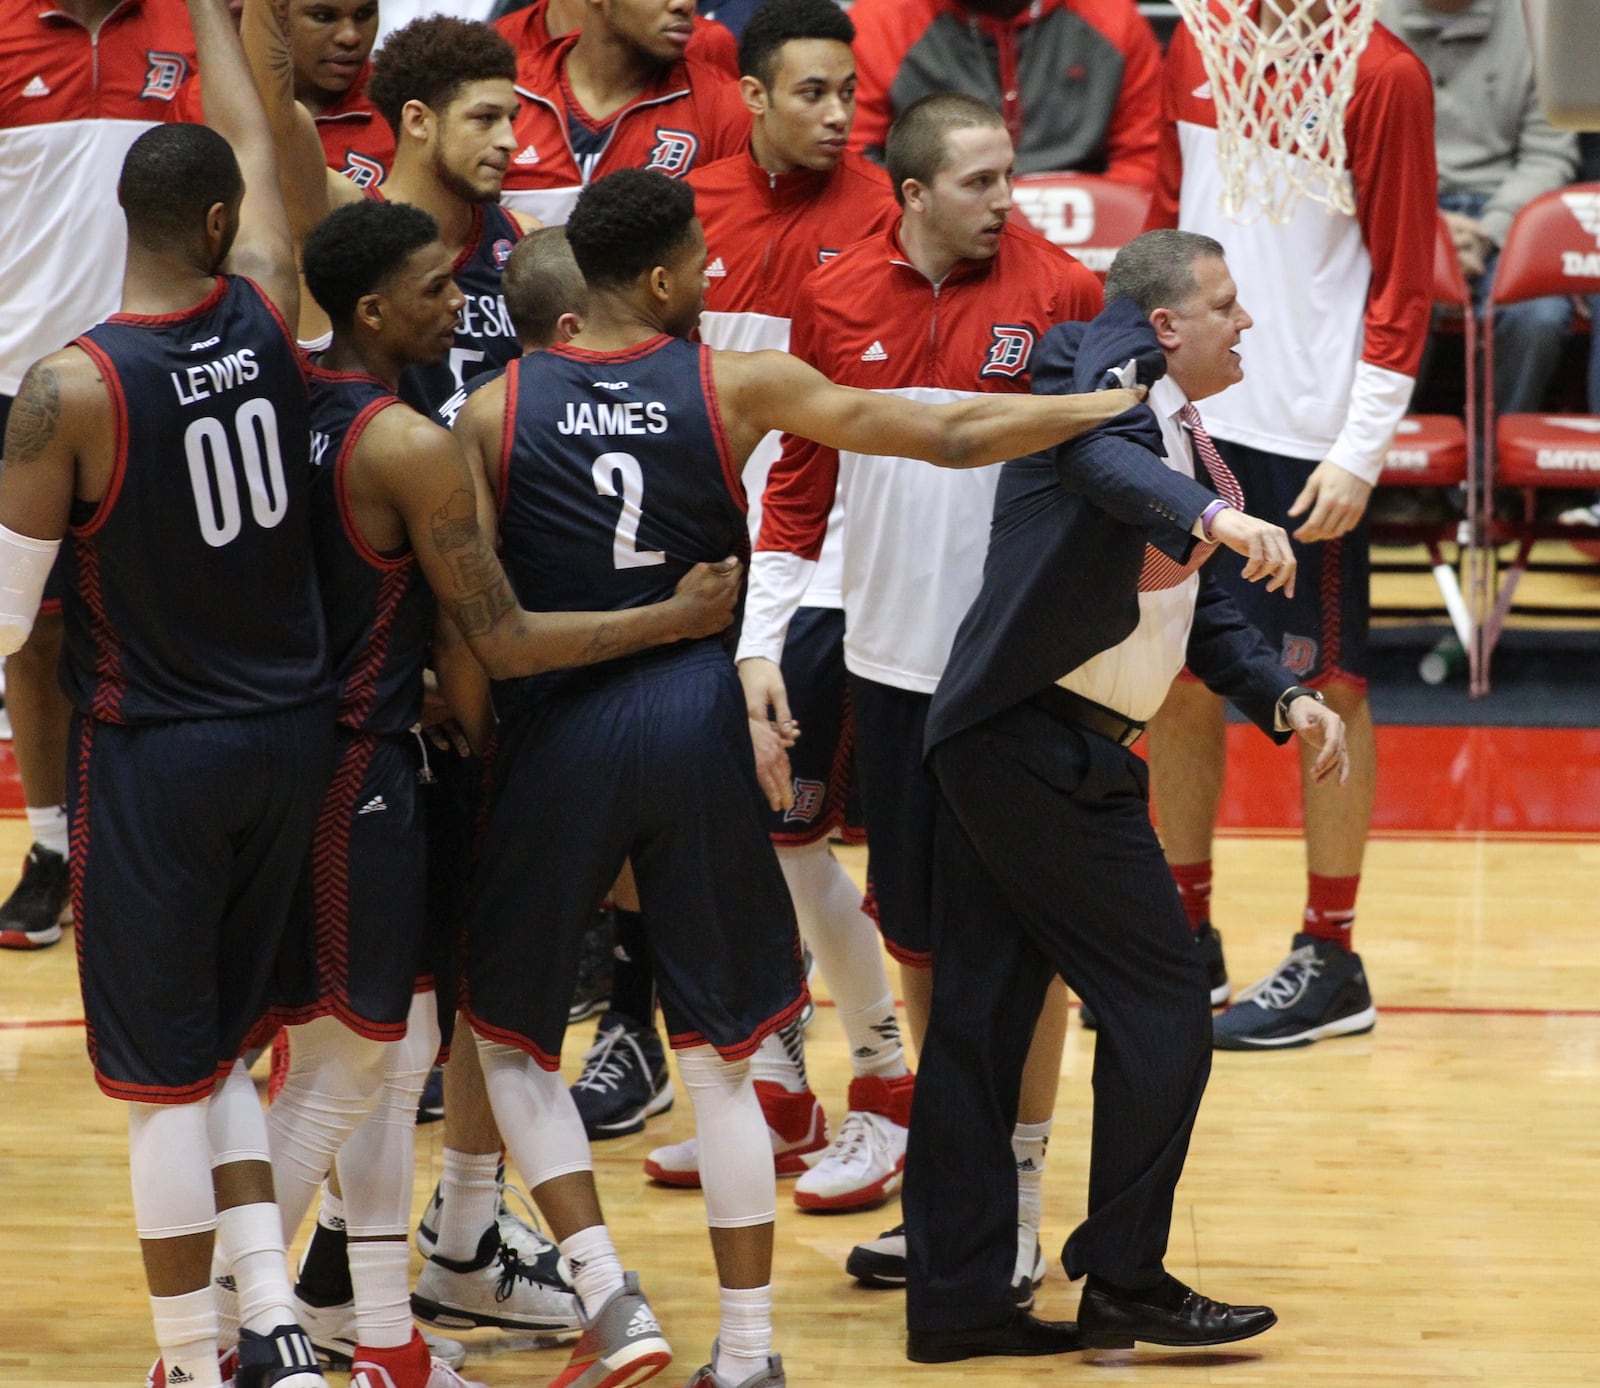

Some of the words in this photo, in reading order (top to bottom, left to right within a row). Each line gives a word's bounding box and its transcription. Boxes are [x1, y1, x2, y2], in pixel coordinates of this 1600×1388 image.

[171, 348, 259, 406] LEWIS
[556, 401, 669, 436] JAMES
[184, 397, 288, 548] 00
[592, 452, 666, 570] 2
